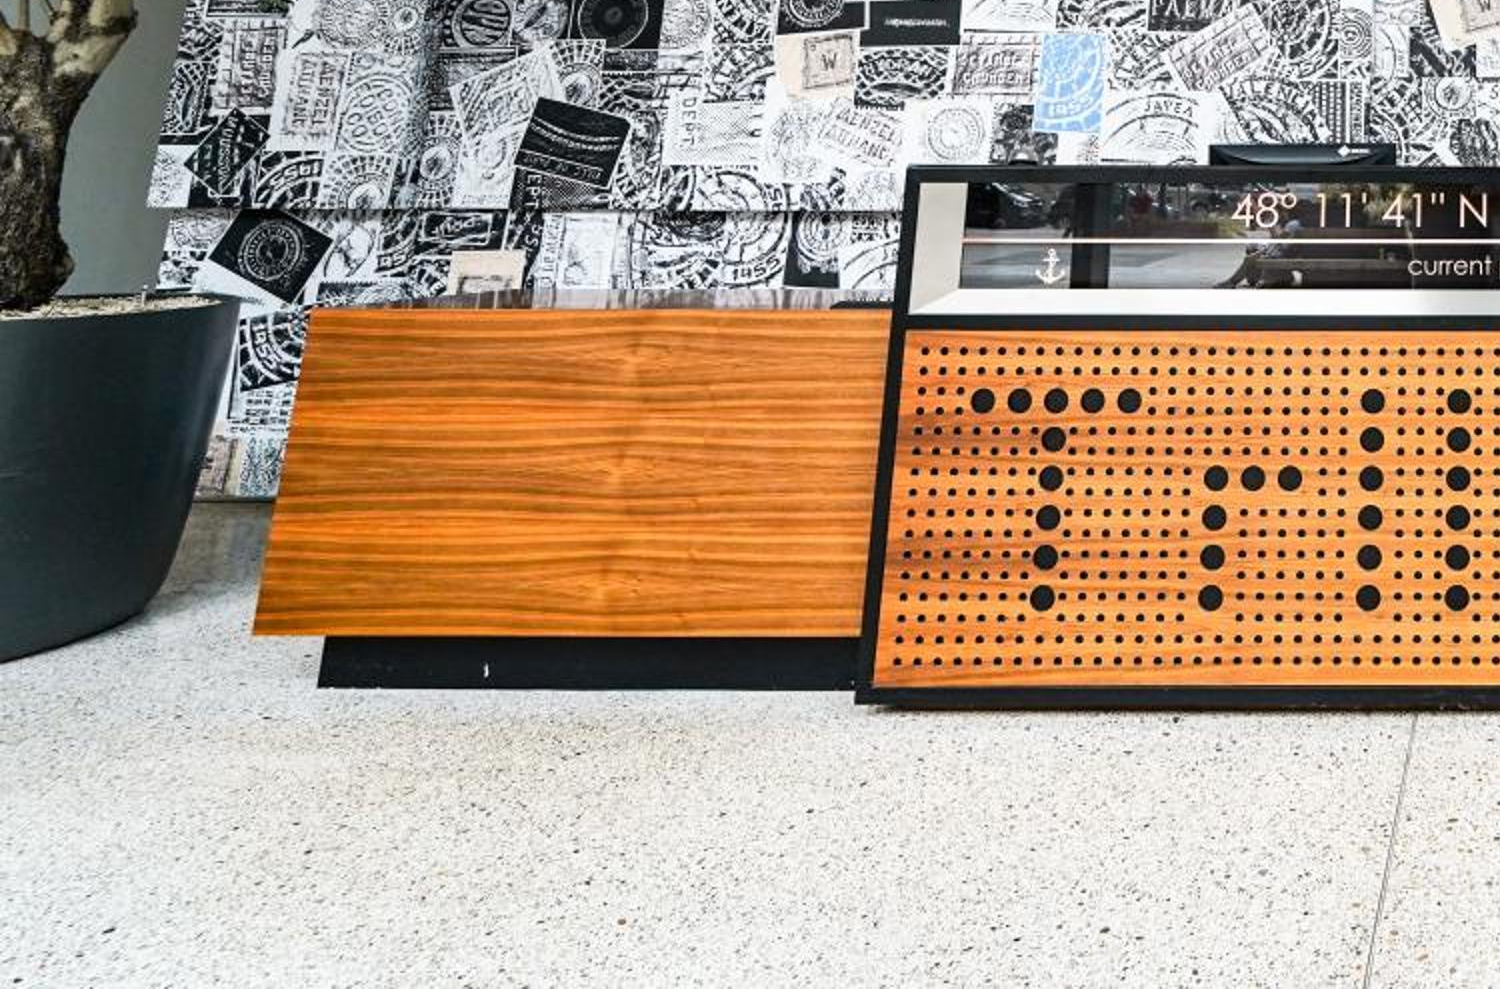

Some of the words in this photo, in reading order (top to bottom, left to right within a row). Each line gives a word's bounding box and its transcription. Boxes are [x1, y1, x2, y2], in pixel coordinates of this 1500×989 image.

[1315, 192, 1368, 230] 11'
[1380, 192, 1445, 230] 41"
[1459, 192, 1488, 230] N
[1407, 257, 1492, 277] current
